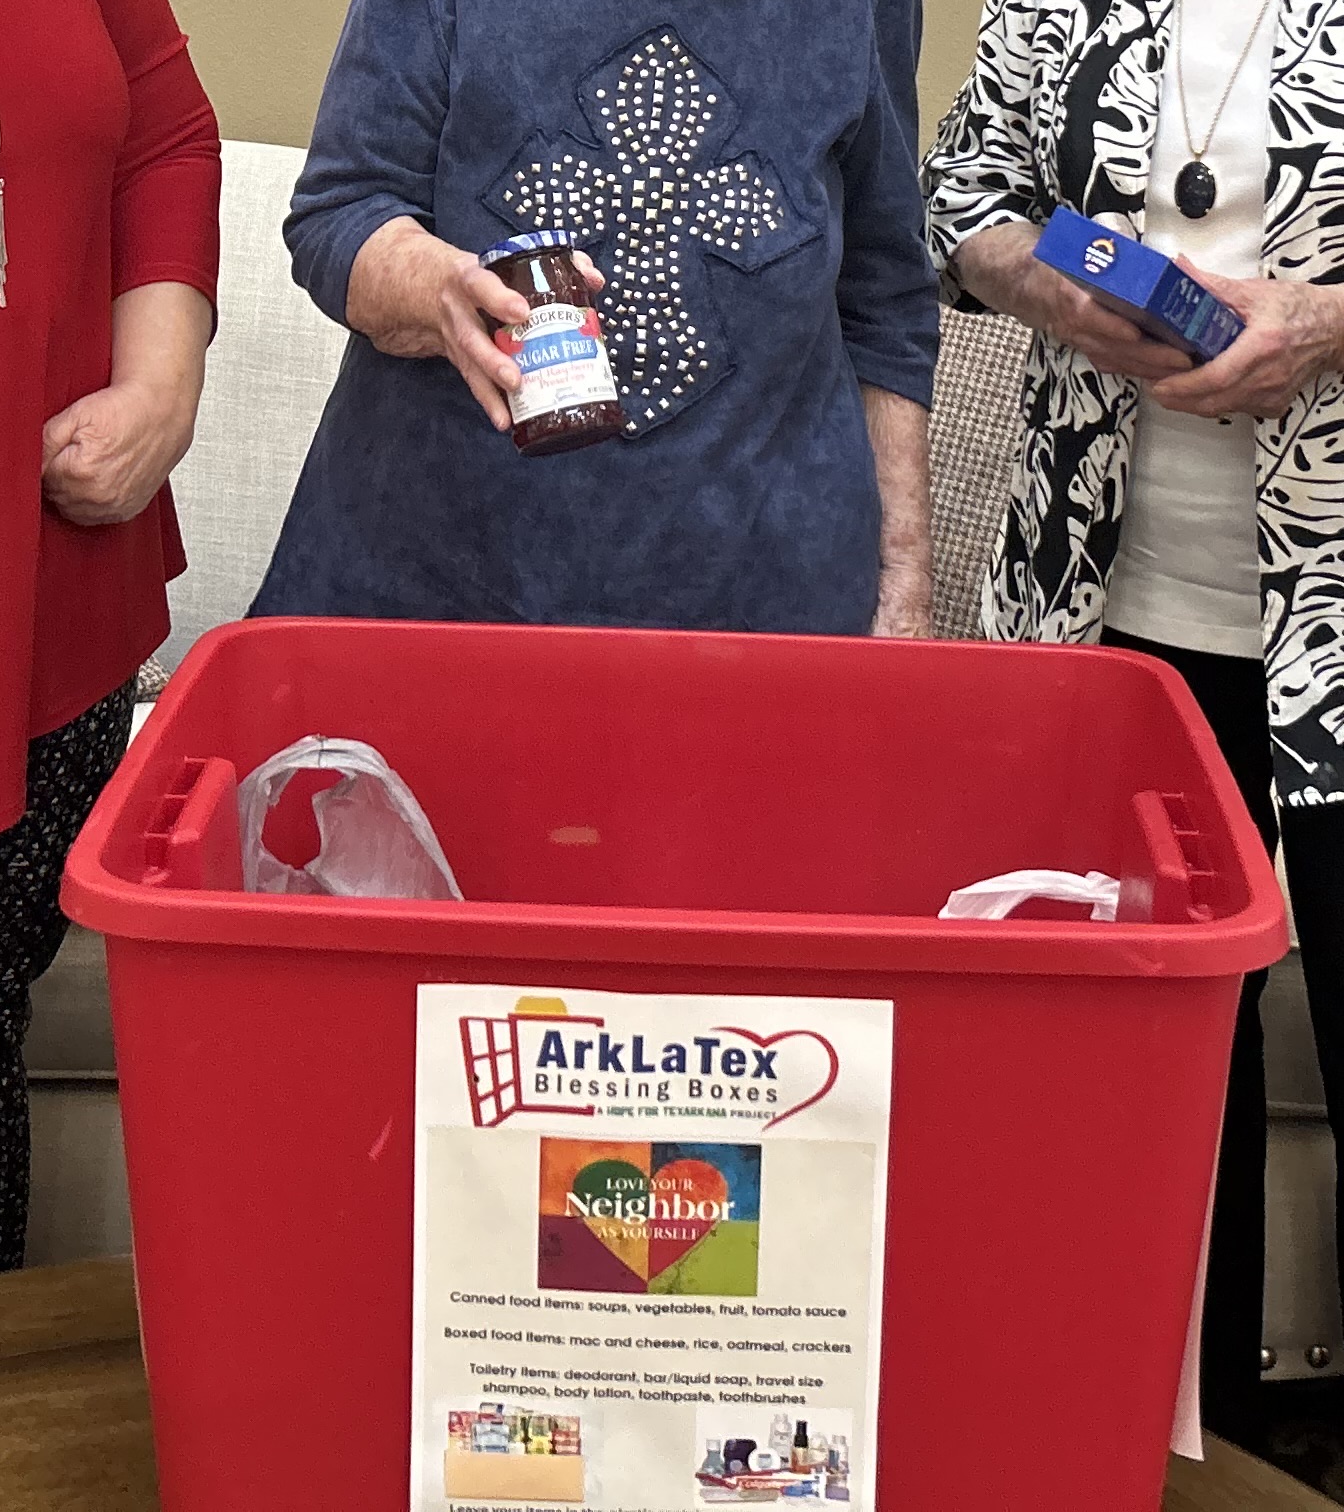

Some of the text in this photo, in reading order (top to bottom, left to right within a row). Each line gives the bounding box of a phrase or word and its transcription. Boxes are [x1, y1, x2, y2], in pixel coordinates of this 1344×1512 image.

[516, 340, 594, 367] SUGAR FREE
[536, 1029, 778, 1080] ArkLaTex
[534, 1073, 778, 1103] Blessing Boxes
[607, 1105, 634, 1118] HOPE
[638, 1106, 659, 1117] FOR
[663, 1106, 726, 1118] TEXARKANA
[730, 1109, 777, 1119] PROJECT
[607, 1177, 693, 1192] LOVE YOUR
[564, 1191, 736, 1225] Neighbor
[597, 1226, 699, 1240] AS YOURSELF
[450, 1291, 847, 1317] Canned food items: soups, vegetables, fruit, tomato sauce
[444, 1326, 852, 1354] Boxed food items: mac and cheese, rice, oatmeal, crackers
[470, 1362, 824, 1388] Toiletry items: deodorant, bar/liquid soap, travel size
[483, 1382, 807, 1404] shampoo, body lotion, toothpaste, toothbrushes
